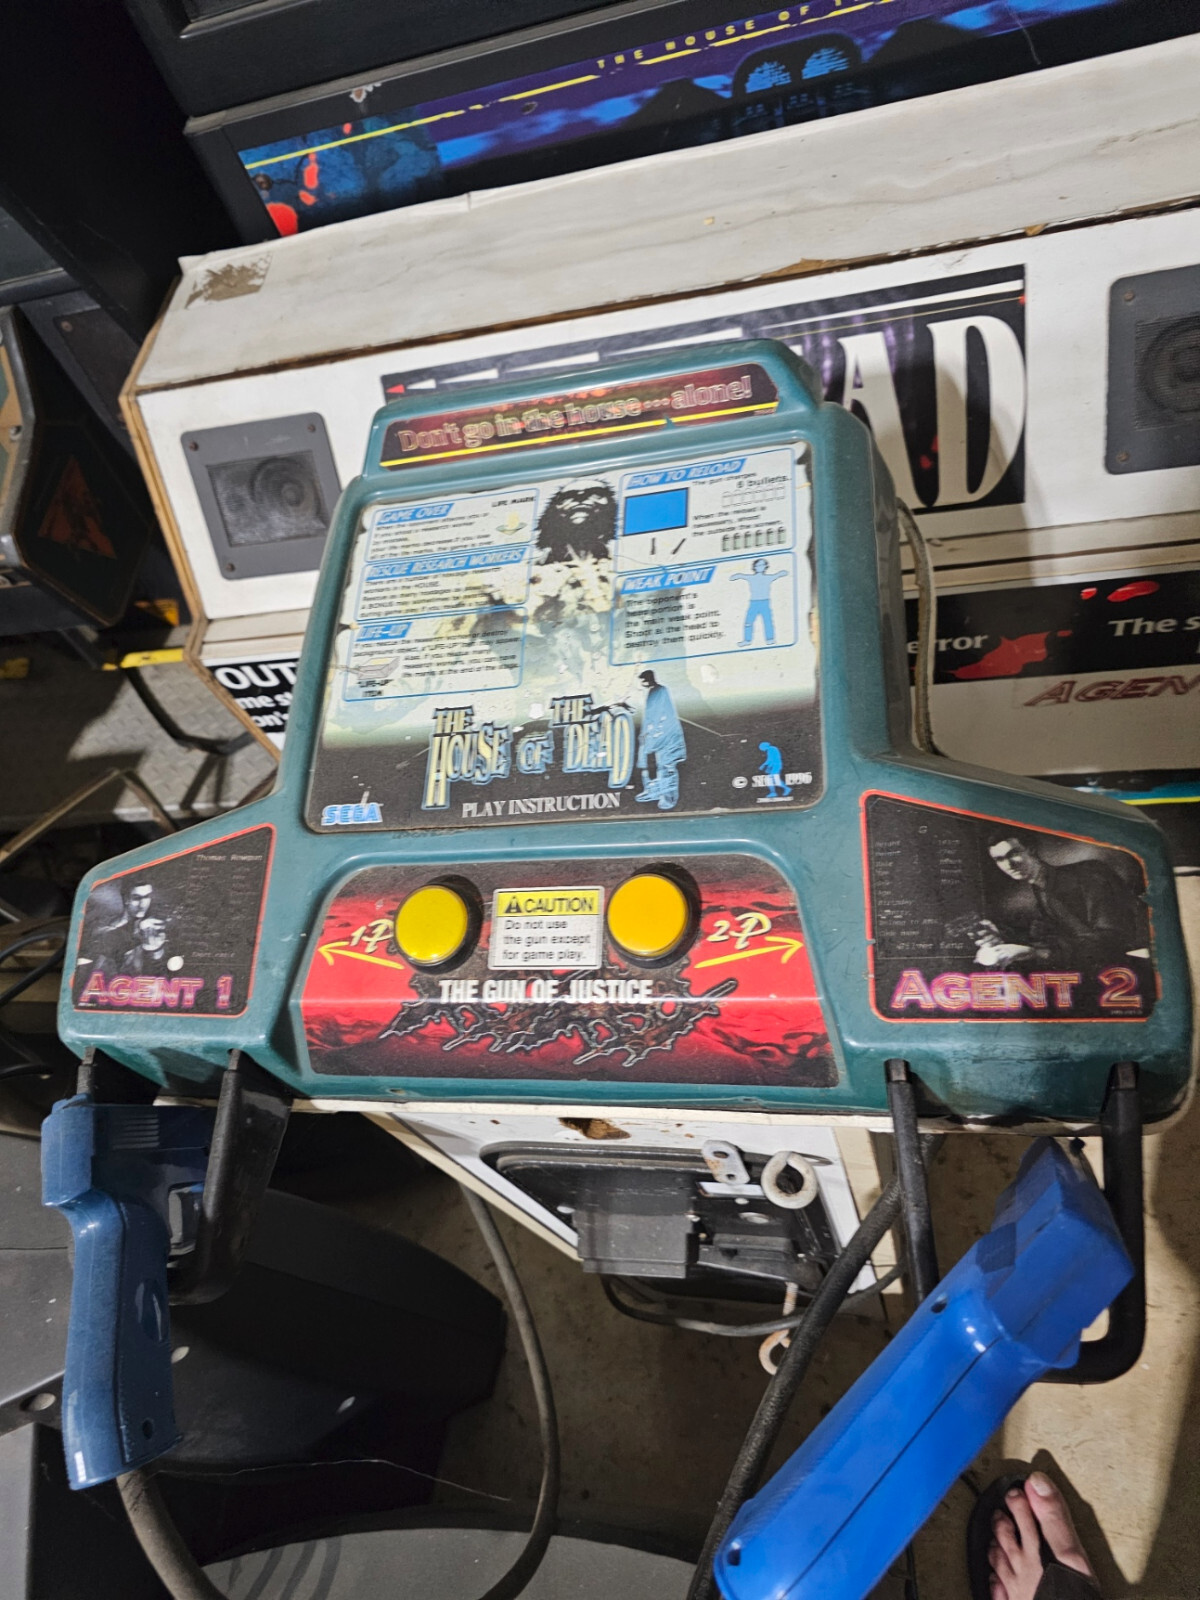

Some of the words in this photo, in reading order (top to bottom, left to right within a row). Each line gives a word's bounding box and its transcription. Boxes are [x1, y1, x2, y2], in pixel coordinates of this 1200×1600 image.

[597, 49, 643, 69] THE
[664, 20, 755, 51] HOUSE
[778, 5, 810, 22] OF
[397, 421, 460, 452] Don't
[462, 421, 494, 449] go
[496, 414, 522, 437] in
[523, 407, 565, 434] the
[670, 375, 752, 410] alone!
[626, 472, 661, 487] HOW
[664, 468, 686, 482] TO
[414, 503, 449, 519] OVER
[623, 573, 661, 591] WEAK
[664, 567, 712, 586] POINT
[1108, 618, 1177, 636] The
[432, 705, 474, 732] THE
[550, 693, 597, 725] THE
[562, 709, 635, 788] DEAD
[422, 722, 512, 810] HOUSE
[516, 733, 554, 774] OF
[321, 803, 383, 825] SEGA
[462, 801, 505, 818] PLAY
[508, 792, 621, 815] INSTRUCTION
[523, 896, 594, 913] CAUTION
[350, 918, 395, 953] 1P
[504, 919, 520, 930] Do
[523, 919, 543, 929] not
[546, 919, 568, 929] use
[706, 912, 772, 950] 2P
[503, 934, 523, 945] the
[526, 935, 549, 948] gun
[551, 933, 591, 947] except
[502, 949, 520, 961] for
[522, 951, 554, 964] game
[556, 949, 586, 964] play.
[80, 970, 204, 1008] AGENT
[215, 974, 233, 1009] 1
[439, 980, 480, 1004] THE
[482, 980, 527, 1003] GUN
[529, 980, 560, 1003] OF
[567, 979, 654, 1003] JUSTICE
[890, 968, 1081, 1011] AGENT
[1098, 966, 1142, 1008] 2
